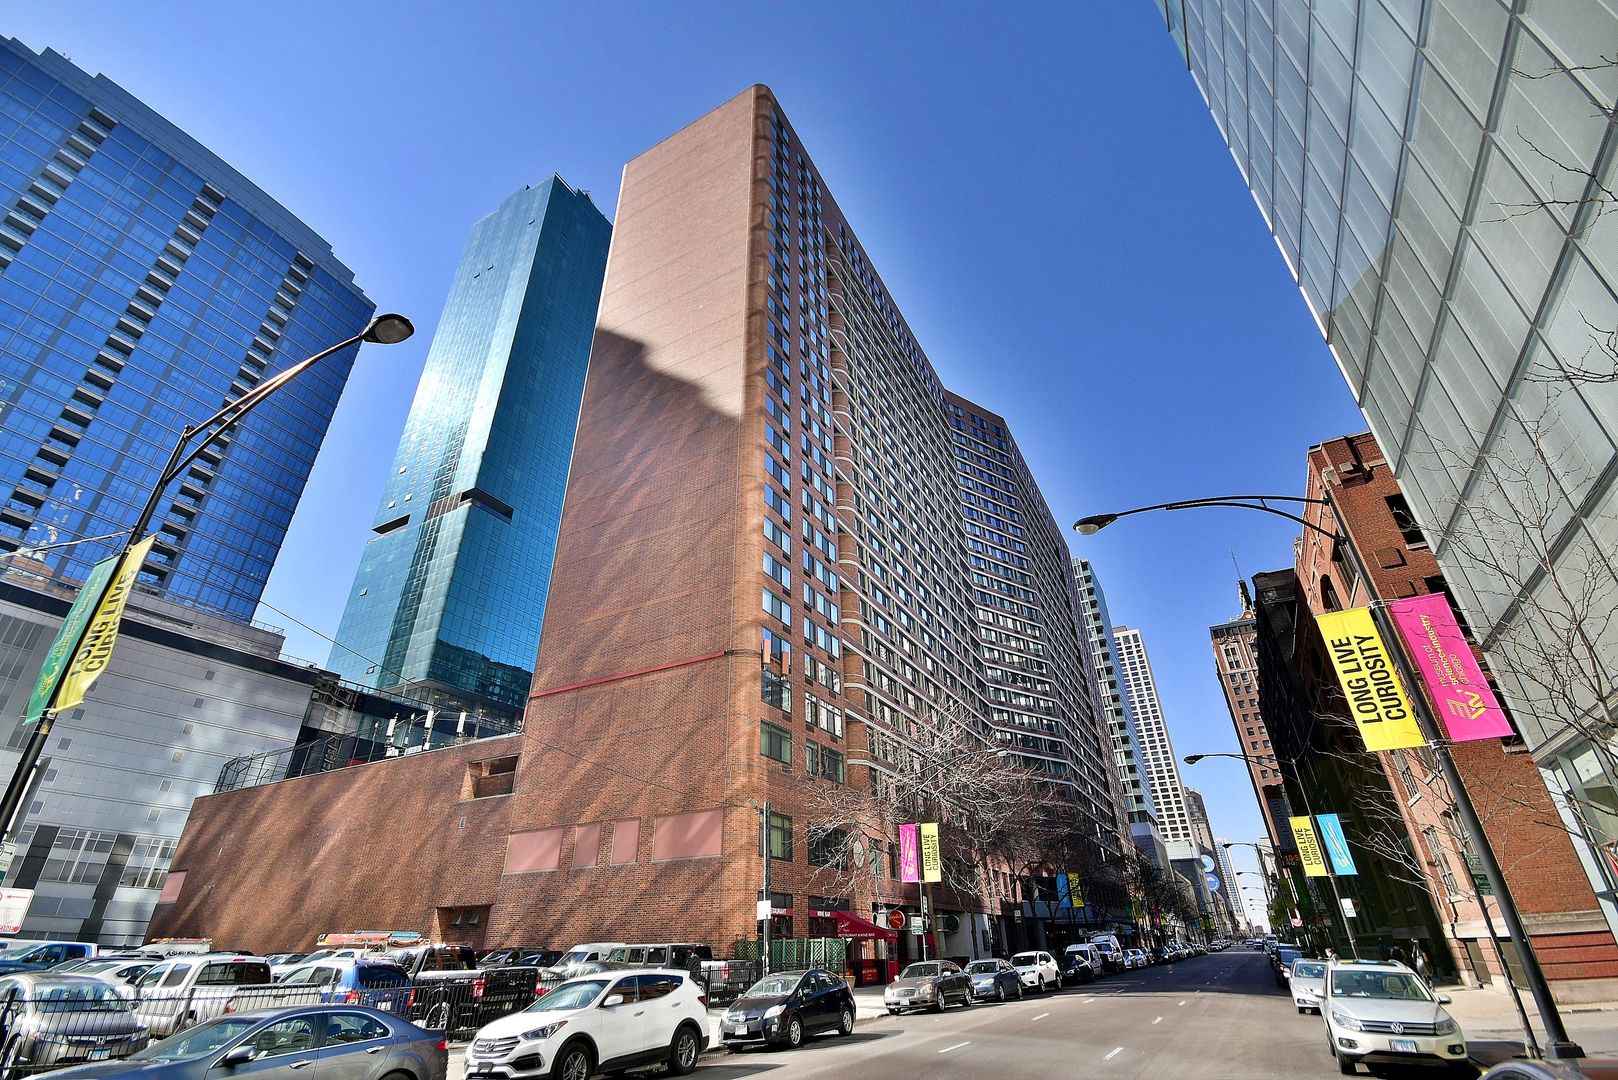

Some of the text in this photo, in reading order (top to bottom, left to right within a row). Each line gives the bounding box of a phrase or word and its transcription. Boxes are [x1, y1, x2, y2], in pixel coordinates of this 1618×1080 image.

[102, 575, 127, 616] LIVE
[1330, 636, 1383, 724] LONG LIVE
[1353, 635, 1407, 721] CURIOSITY
[1421, 644, 1449, 687] museum of
[1449, 653, 1470, 685] chicago
[924, 851, 932, 871] LONG
[931, 834, 939, 871] CURIOSITY
[1295, 827, 1314, 866] LONG LIVE
[1304, 827, 1322, 865] CURIOSITY
